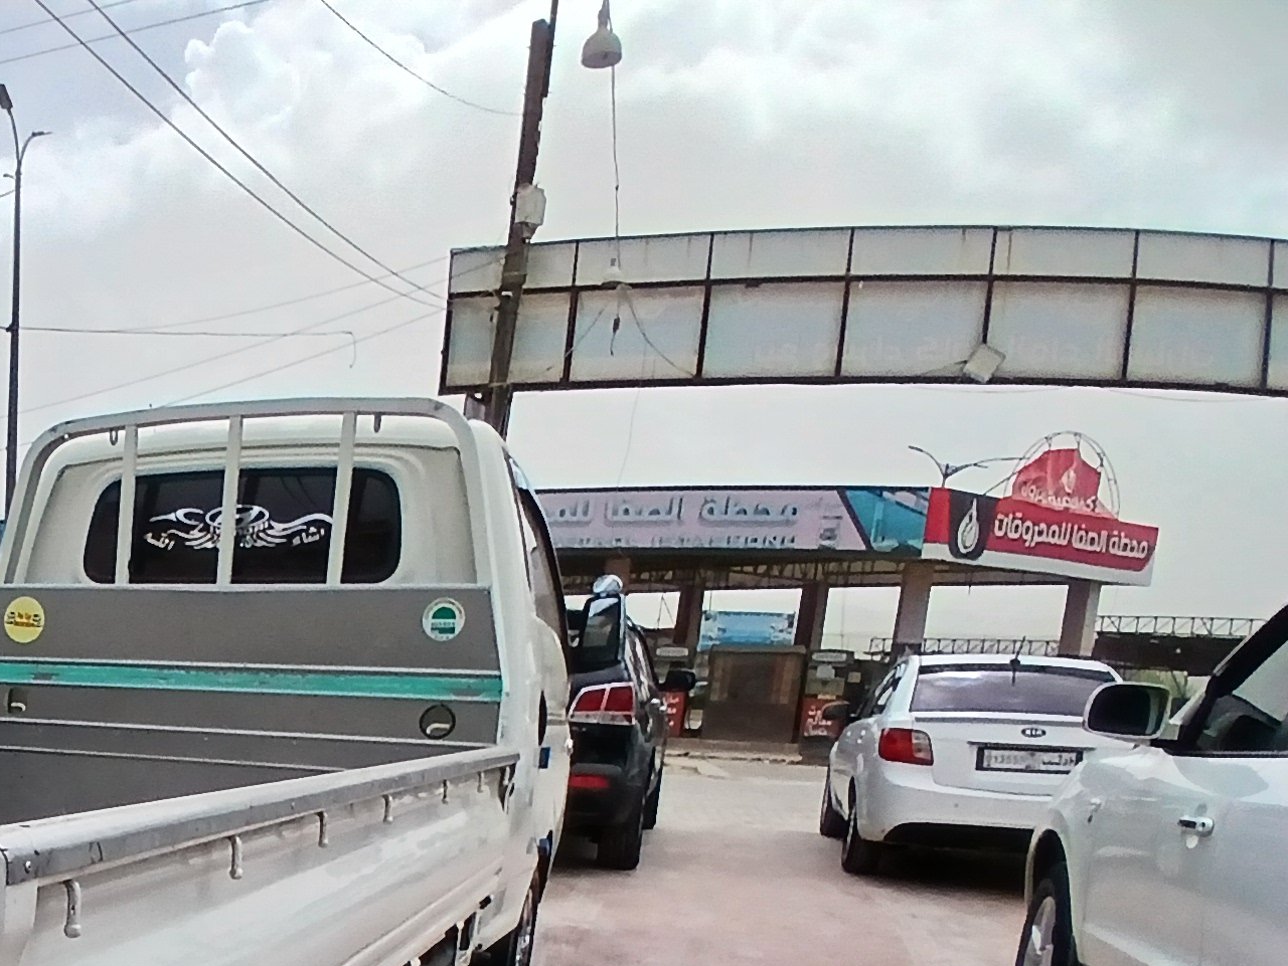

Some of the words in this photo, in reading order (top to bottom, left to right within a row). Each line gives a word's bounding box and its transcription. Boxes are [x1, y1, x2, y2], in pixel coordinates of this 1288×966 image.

[604, 495, 685, 523] الصفا
[698, 494, 799, 523] محطة
[993, 511, 1072, 548] للمحروقات
[1071, 524, 1107, 554] الصفا
[1109, 529, 1149, 559] محطة
